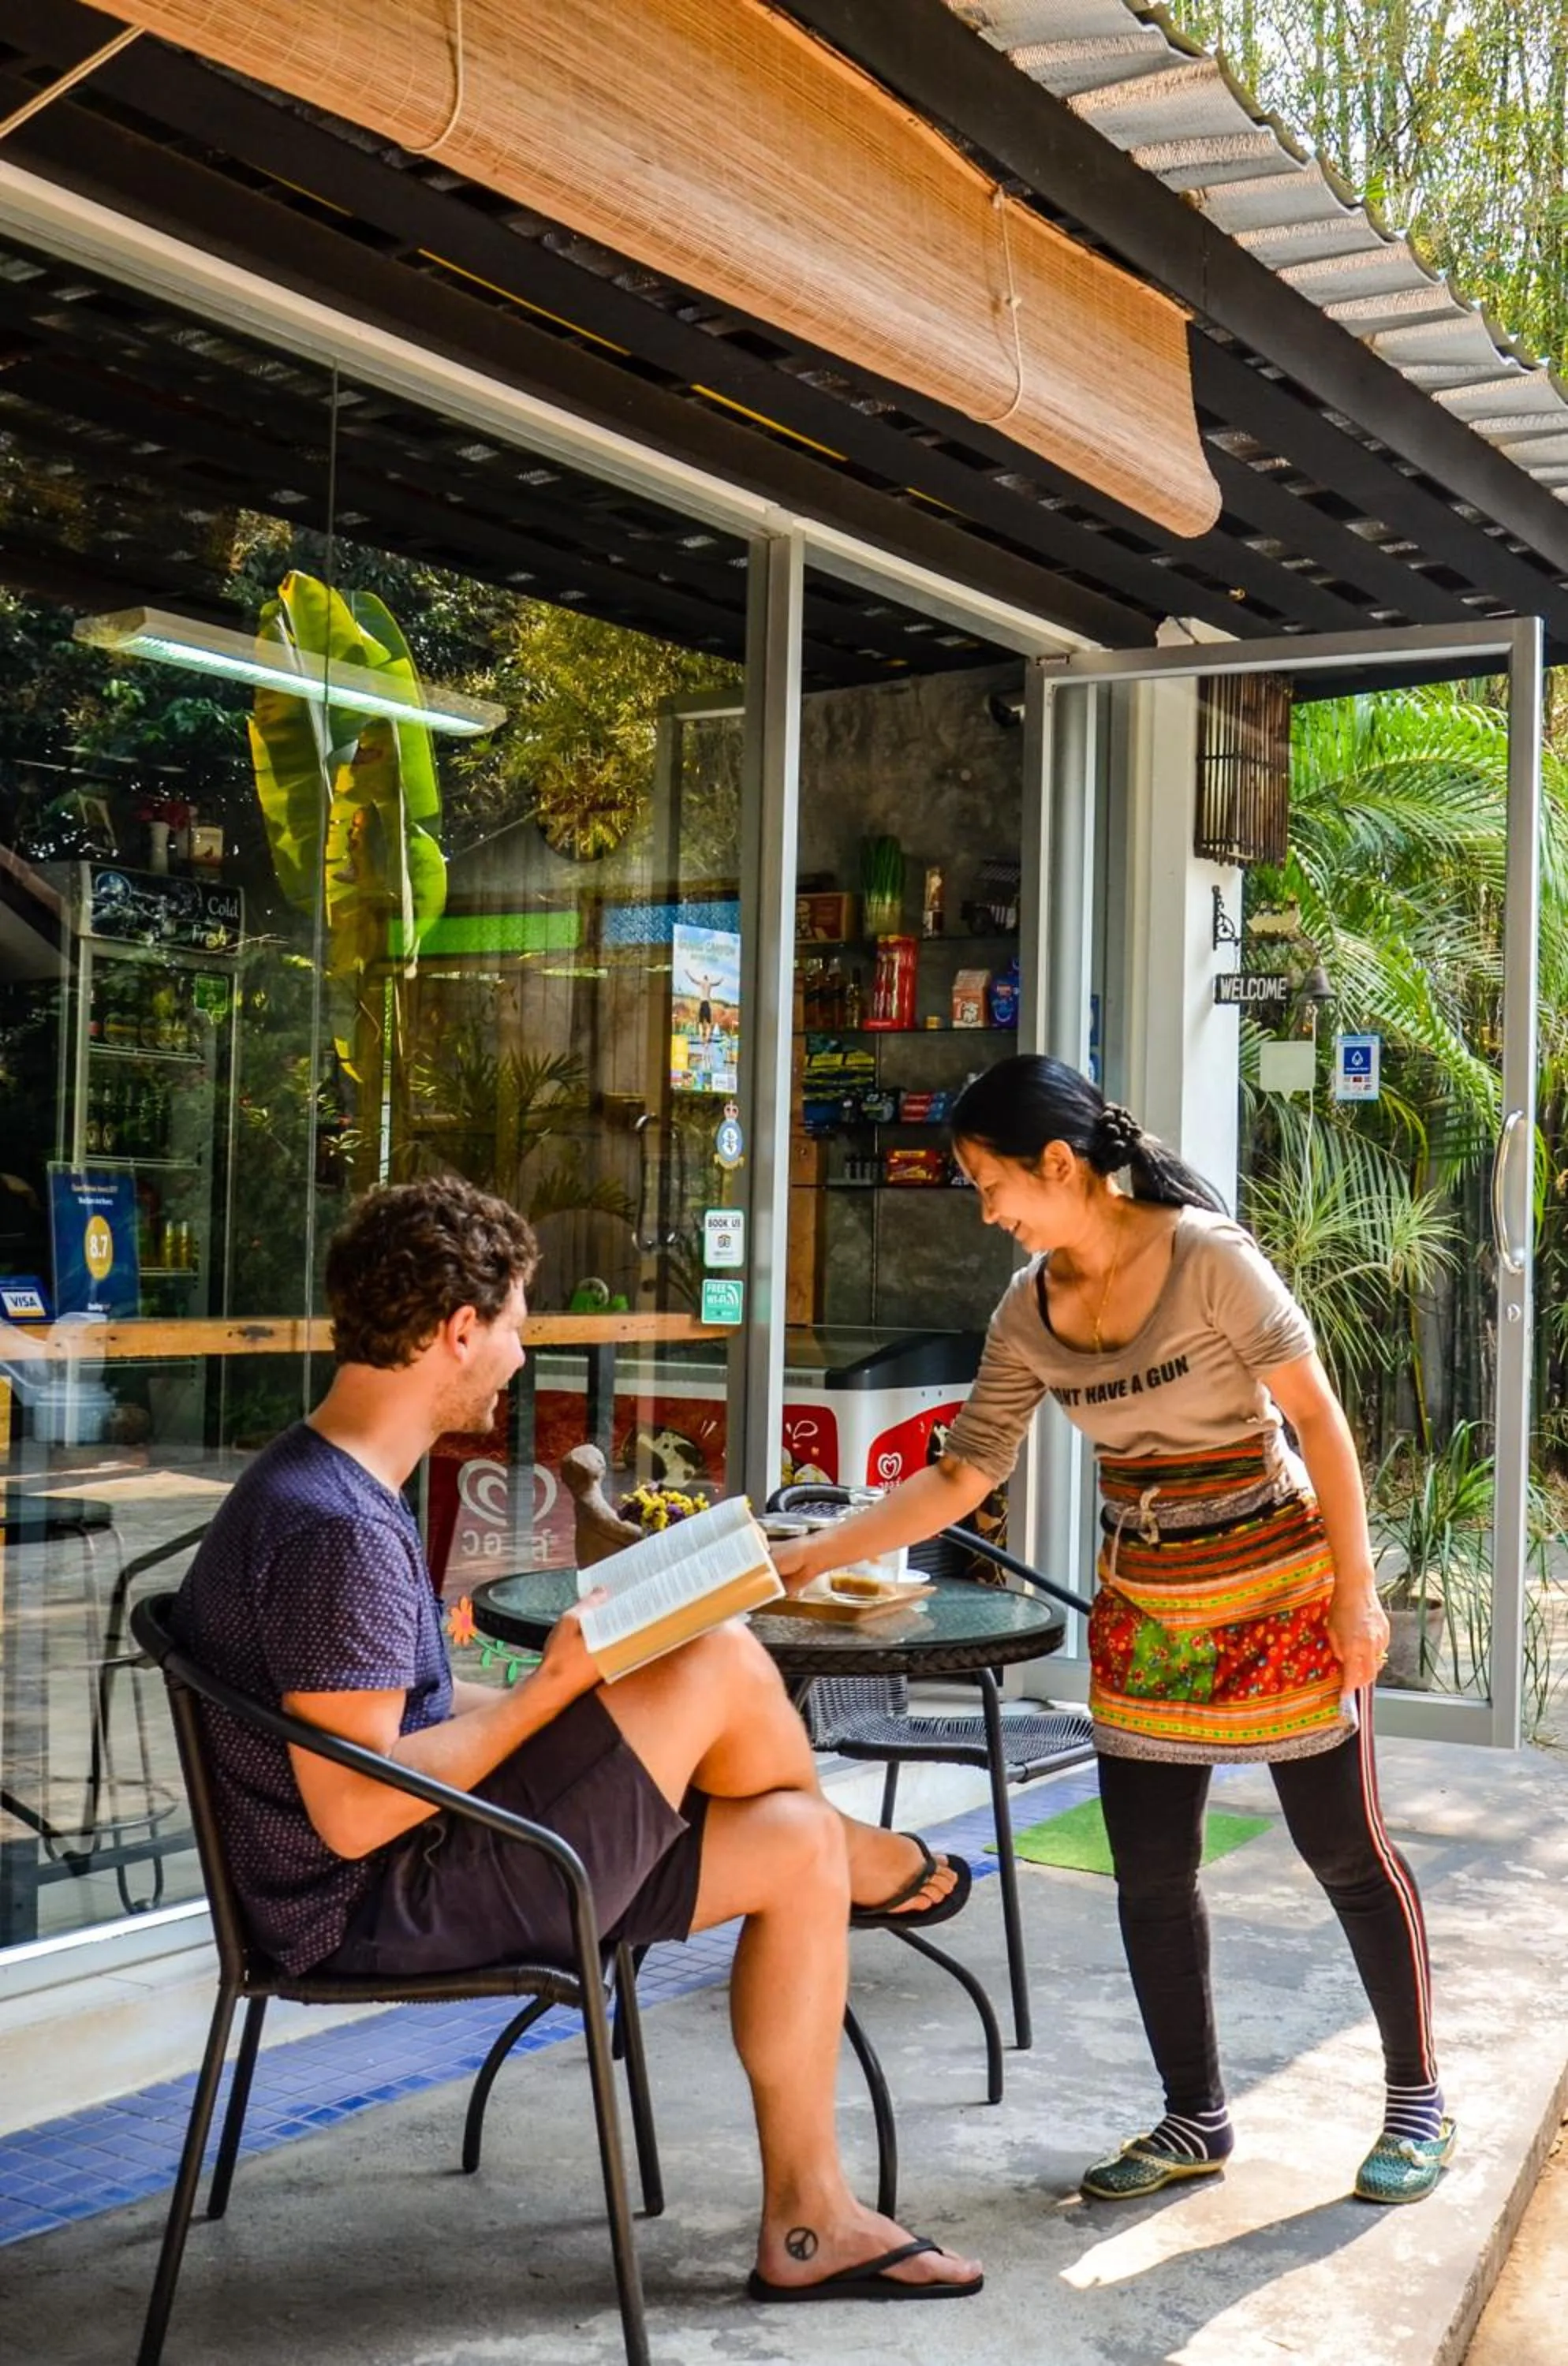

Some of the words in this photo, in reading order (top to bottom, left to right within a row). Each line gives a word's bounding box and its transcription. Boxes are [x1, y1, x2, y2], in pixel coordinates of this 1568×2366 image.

[208, 896, 239, 918] Cold
[1220, 977, 1287, 1001] WELCOME
[707, 1218, 728, 1228] BOOK
[89, 1233, 108, 1259] 8.7
[706, 1283, 726, 1293] FREE
[9, 1296, 38, 1307] VISA
[1085, 1379, 1128, 1405] HAVE
[1131, 1373, 1144, 1395] A
[1146, 1354, 1189, 1389] GUN
